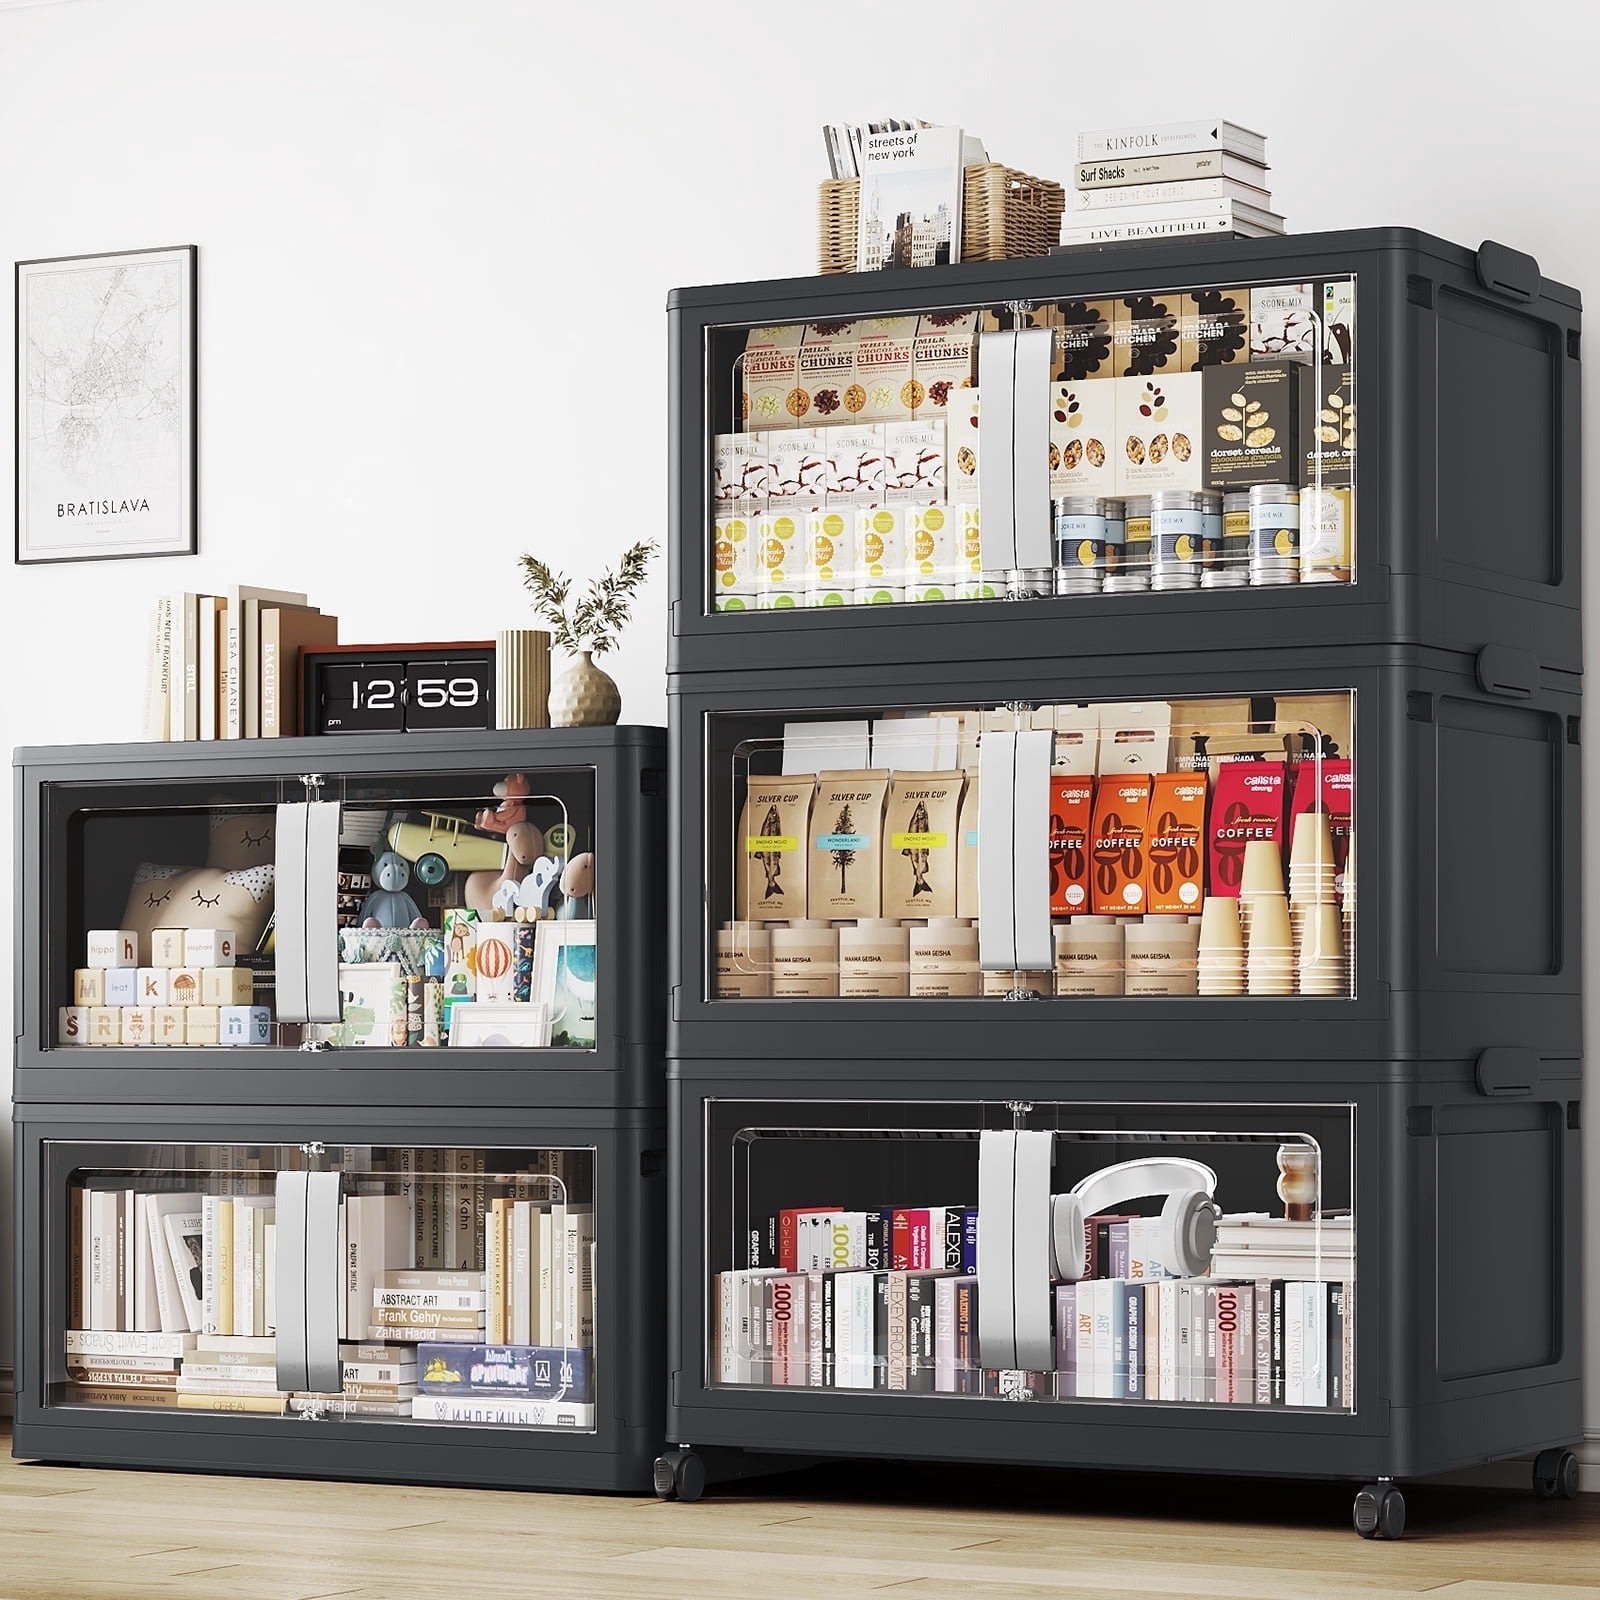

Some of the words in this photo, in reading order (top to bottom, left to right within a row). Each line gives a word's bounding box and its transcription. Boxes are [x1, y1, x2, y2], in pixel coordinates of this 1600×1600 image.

[868, 137, 904, 149] streets
[906, 133, 918, 144] of
[1106, 133, 1159, 151] KINFOLK
[868, 151, 890, 160] new
[892, 147, 915, 160] york
[1080, 168, 1097, 182] Surf
[1098, 165, 1126, 181] Shacks
[1091, 229, 1122, 240] LIVE
[1127, 221, 1210, 237] BEAUTIFUL
[1260, 297, 1287, 309] SCONE
[1288, 296, 1304, 307] MIX
[1114, 334, 1157, 345] KITCHEN
[1181, 328, 1225, 340] KITCHEN
[801, 356, 853, 368] CHUNKS
[857, 352, 910, 363] CHUNKS
[915, 347, 969, 360] CHUNKS
[778, 442, 802, 452] SCONE
[803, 441, 816, 451] MIX
[836, 439, 860, 449] SCONE
[861, 438, 875, 448] MIX
[895, 434, 920, 445] SCONE
[921, 433, 934, 443] MIX
[1211, 449, 1244, 458] dorset
[1244, 446, 1282, 455] cereals
[1211, 455, 1250, 463] chocolate
[56, 498, 151, 518] BRATISLAVA
[229, 627, 237, 659] LISA
[186, 663, 196, 694] STILL
[264, 642, 275, 728] BAGUETTE
[229, 667, 238, 726] CHANEY
[352, 679, 395, 709] 12
[417, 677, 479, 708] 59
[327, 719, 342, 727] pm
[757, 795, 782, 804] SILVER
[783, 794, 799, 803] CUP
[830, 793, 855, 802] SILVER
[856, 792, 872, 801] CUP
[904, 791, 930, 800] SILVER
[931, 790, 948, 799] CUP
[1216, 827, 1274, 839] COFFEE
[1095, 838, 1141, 848] COFFEE
[1151, 837, 1197, 848] COFFEE
[90, 945, 115, 955] hippo
[124, 938, 134, 960] h
[221, 939, 231, 958] e
[111, 983, 128, 992] leaf
[416, 1198, 426, 1241] furniture
[459, 1197, 468, 1231] Kahn
[751, 1230, 760, 1267] GRAPHIC
[946, 1211, 961, 1270] ALEXEY
[516, 1247, 527, 1273] Dior
[380, 1294, 422, 1306] ABSTRACT
[423, 1294, 439, 1306] ART
[774, 1283, 792, 1321] 1000
[890, 1275, 904, 1323] ALEXEY
[959, 1288, 969, 1322] MAKING
[378, 1309, 408, 1323] Frank
[409, 1309, 442, 1326] Gehry
[810, 1302, 821, 1331] BOOK
[1128, 1296, 1138, 1326] GRAPHIC
[1218, 1292, 1237, 1332] 1000
[375, 1325, 402, 1339] Zaha
[404, 1327, 436, 1340] Hadid
[741, 1316, 749, 1334] EAMES
[911, 1316, 920, 1345] Gardens
[959, 1323, 969, 1333] IT
[1079, 1313, 1092, 1335] ART
[1097, 1313, 1110, 1335] ART
[1208, 1317, 1216, 1330] EERO
[1257, 1312, 1269, 1342] BOOK
[79, 1333, 114, 1353] Snaps
[117, 1335, 148, 1354] Erwitt
[152, 1336, 181, 1355] Elliott
[1128, 1325, 1138, 1350] DESIGN
[344, 1368, 359, 1380] ART
[1257, 1351, 1269, 1402] SYMBOLS
[212, 1400, 246, 1412] CEREAL
